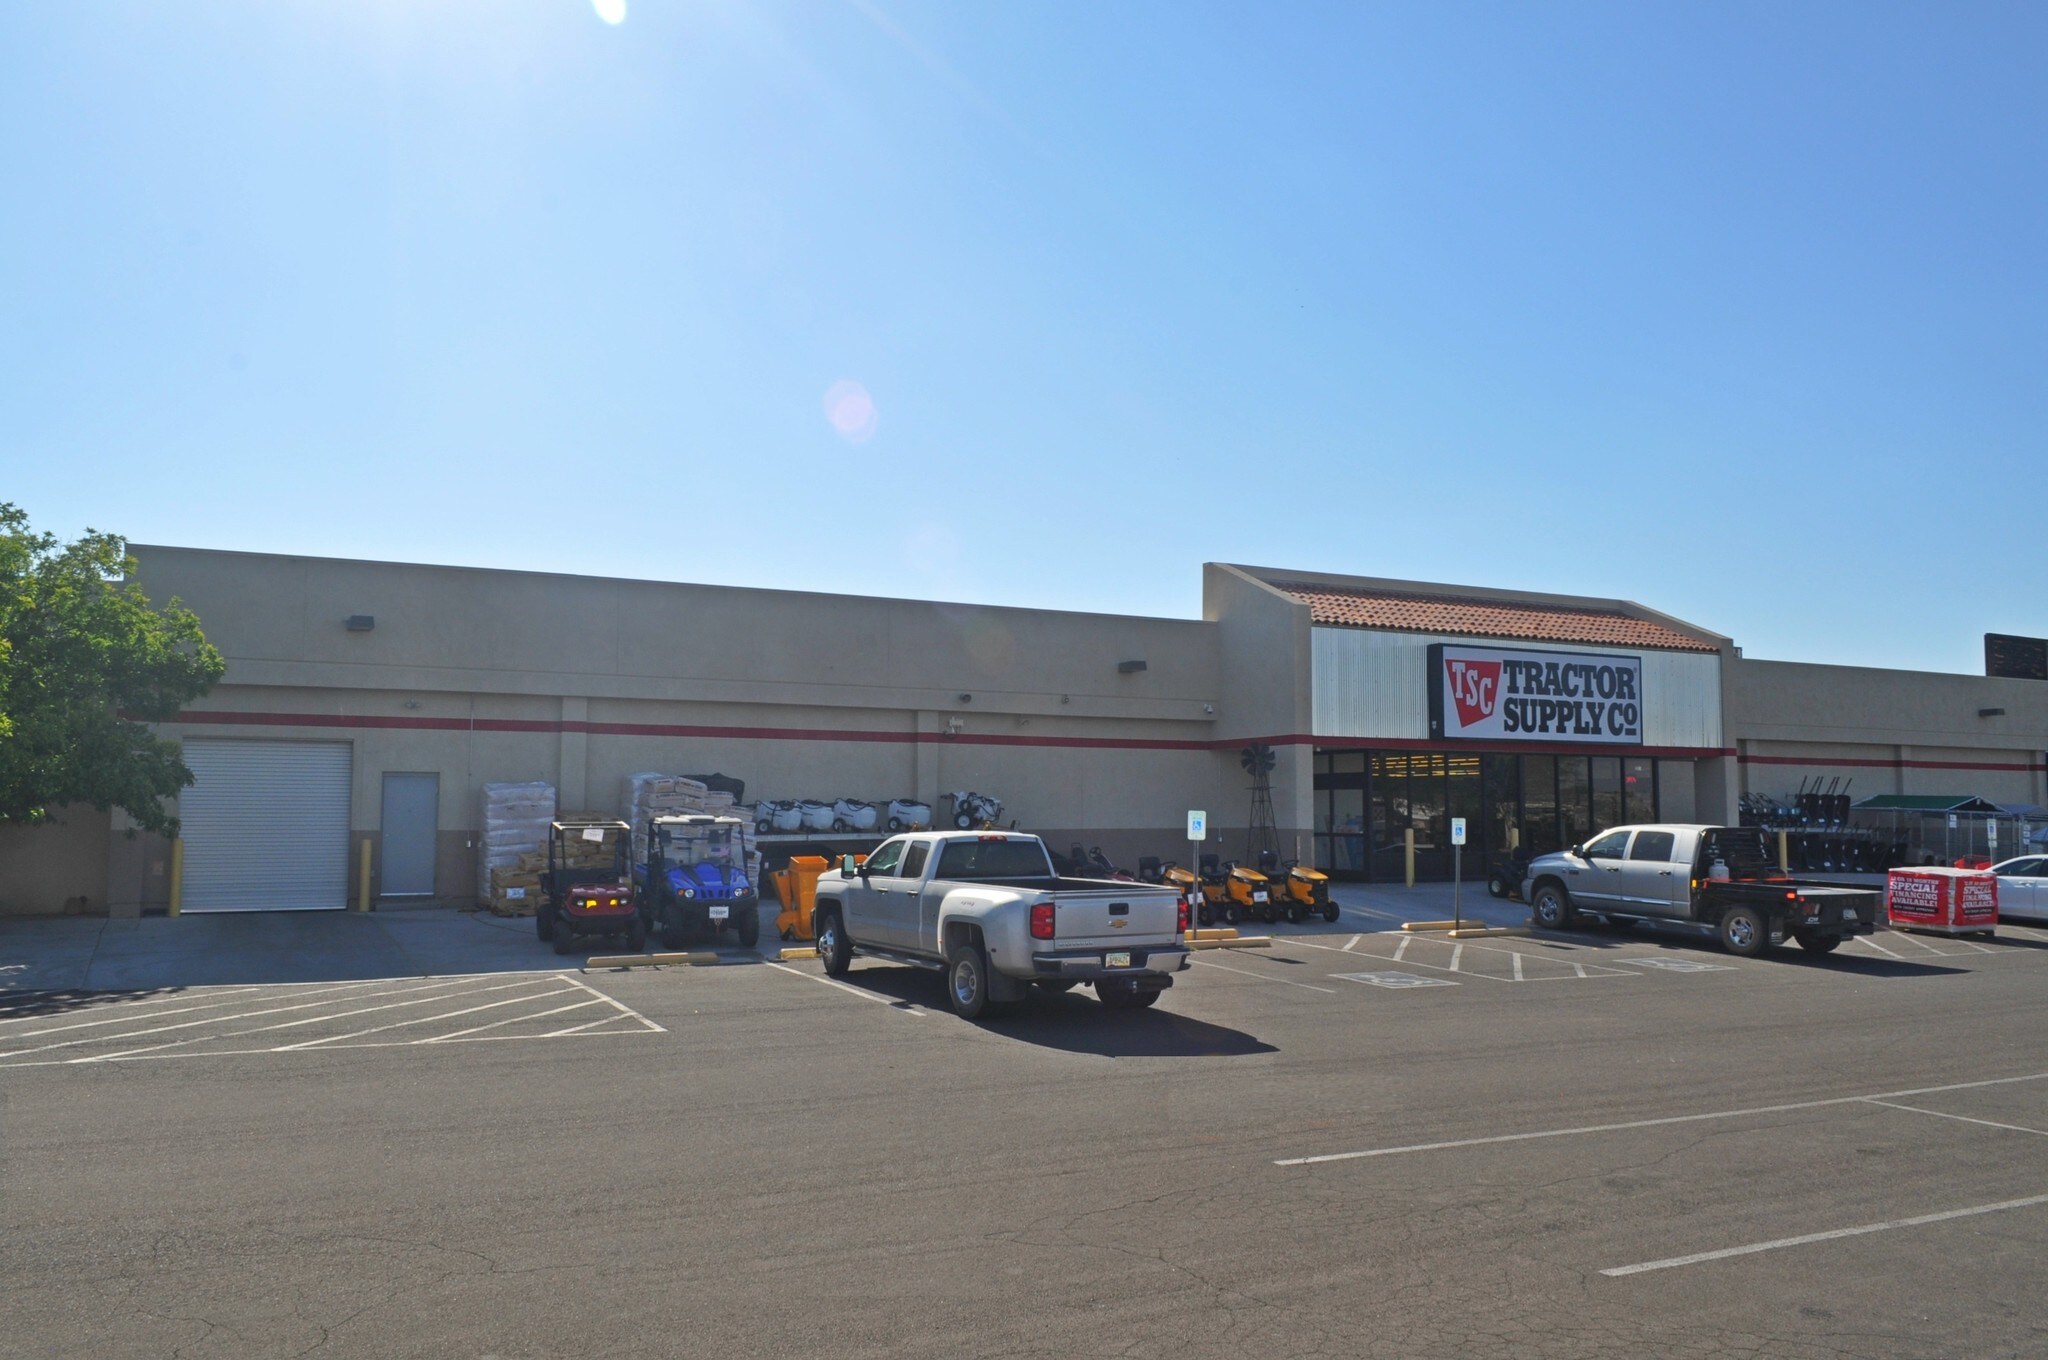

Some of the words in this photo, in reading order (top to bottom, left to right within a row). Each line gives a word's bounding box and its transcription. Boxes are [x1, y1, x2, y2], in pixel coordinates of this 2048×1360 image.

[1452, 662, 1492, 714] TSC
[1503, 660, 1636, 700] TRACTOR
[1503, 697, 1605, 735] SUPPLY
[1890, 881, 1938, 894] SPECIAL
